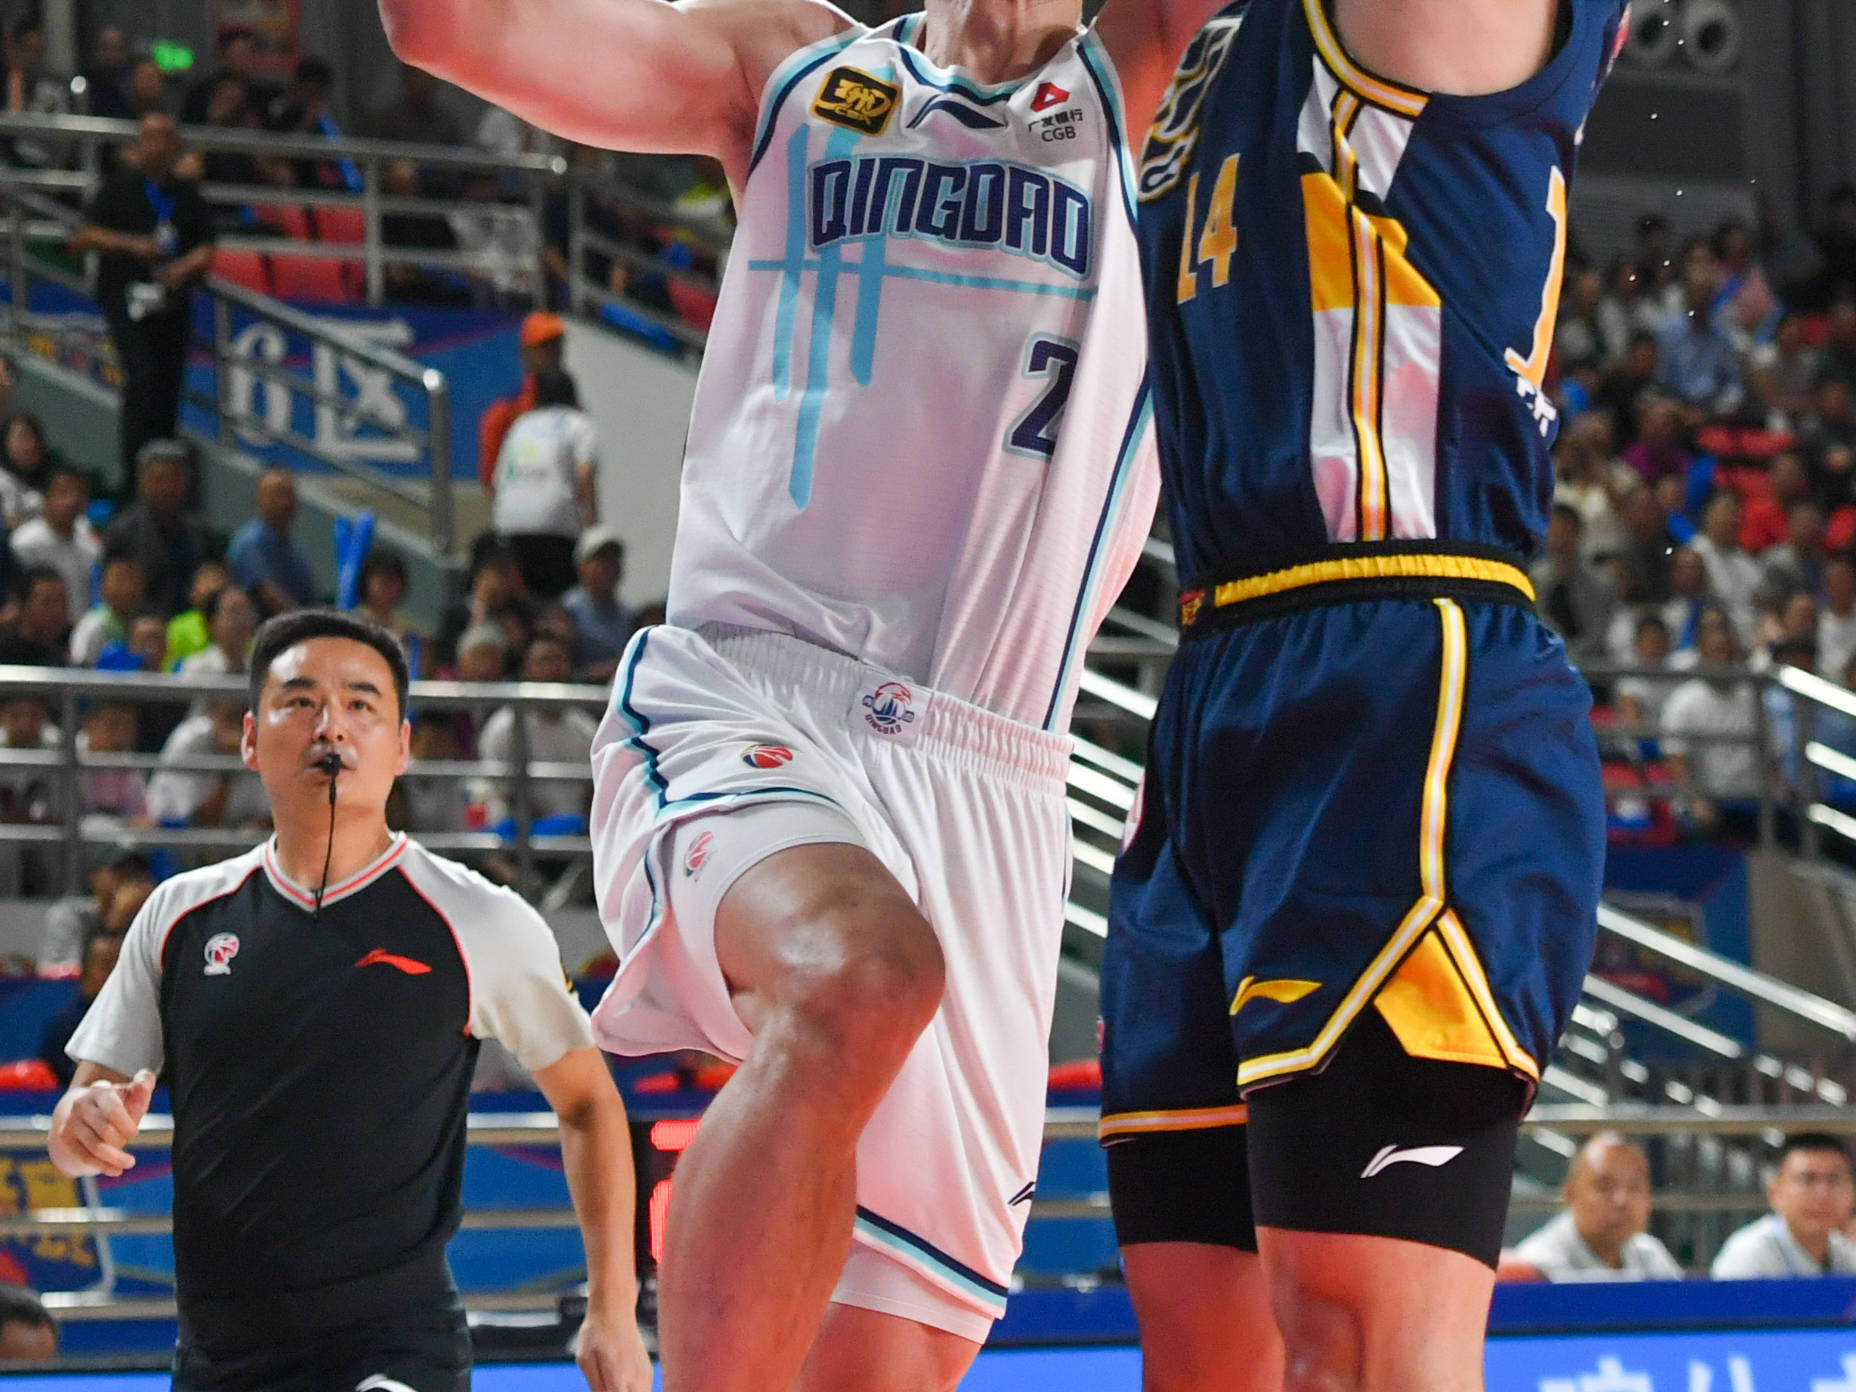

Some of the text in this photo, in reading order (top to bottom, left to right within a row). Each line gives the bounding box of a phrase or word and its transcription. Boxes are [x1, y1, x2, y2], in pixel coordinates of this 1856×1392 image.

[1041, 126, 1076, 142] CGB
[808, 154, 1094, 279] QINGDAO
[1177, 152, 1241, 305] 14
